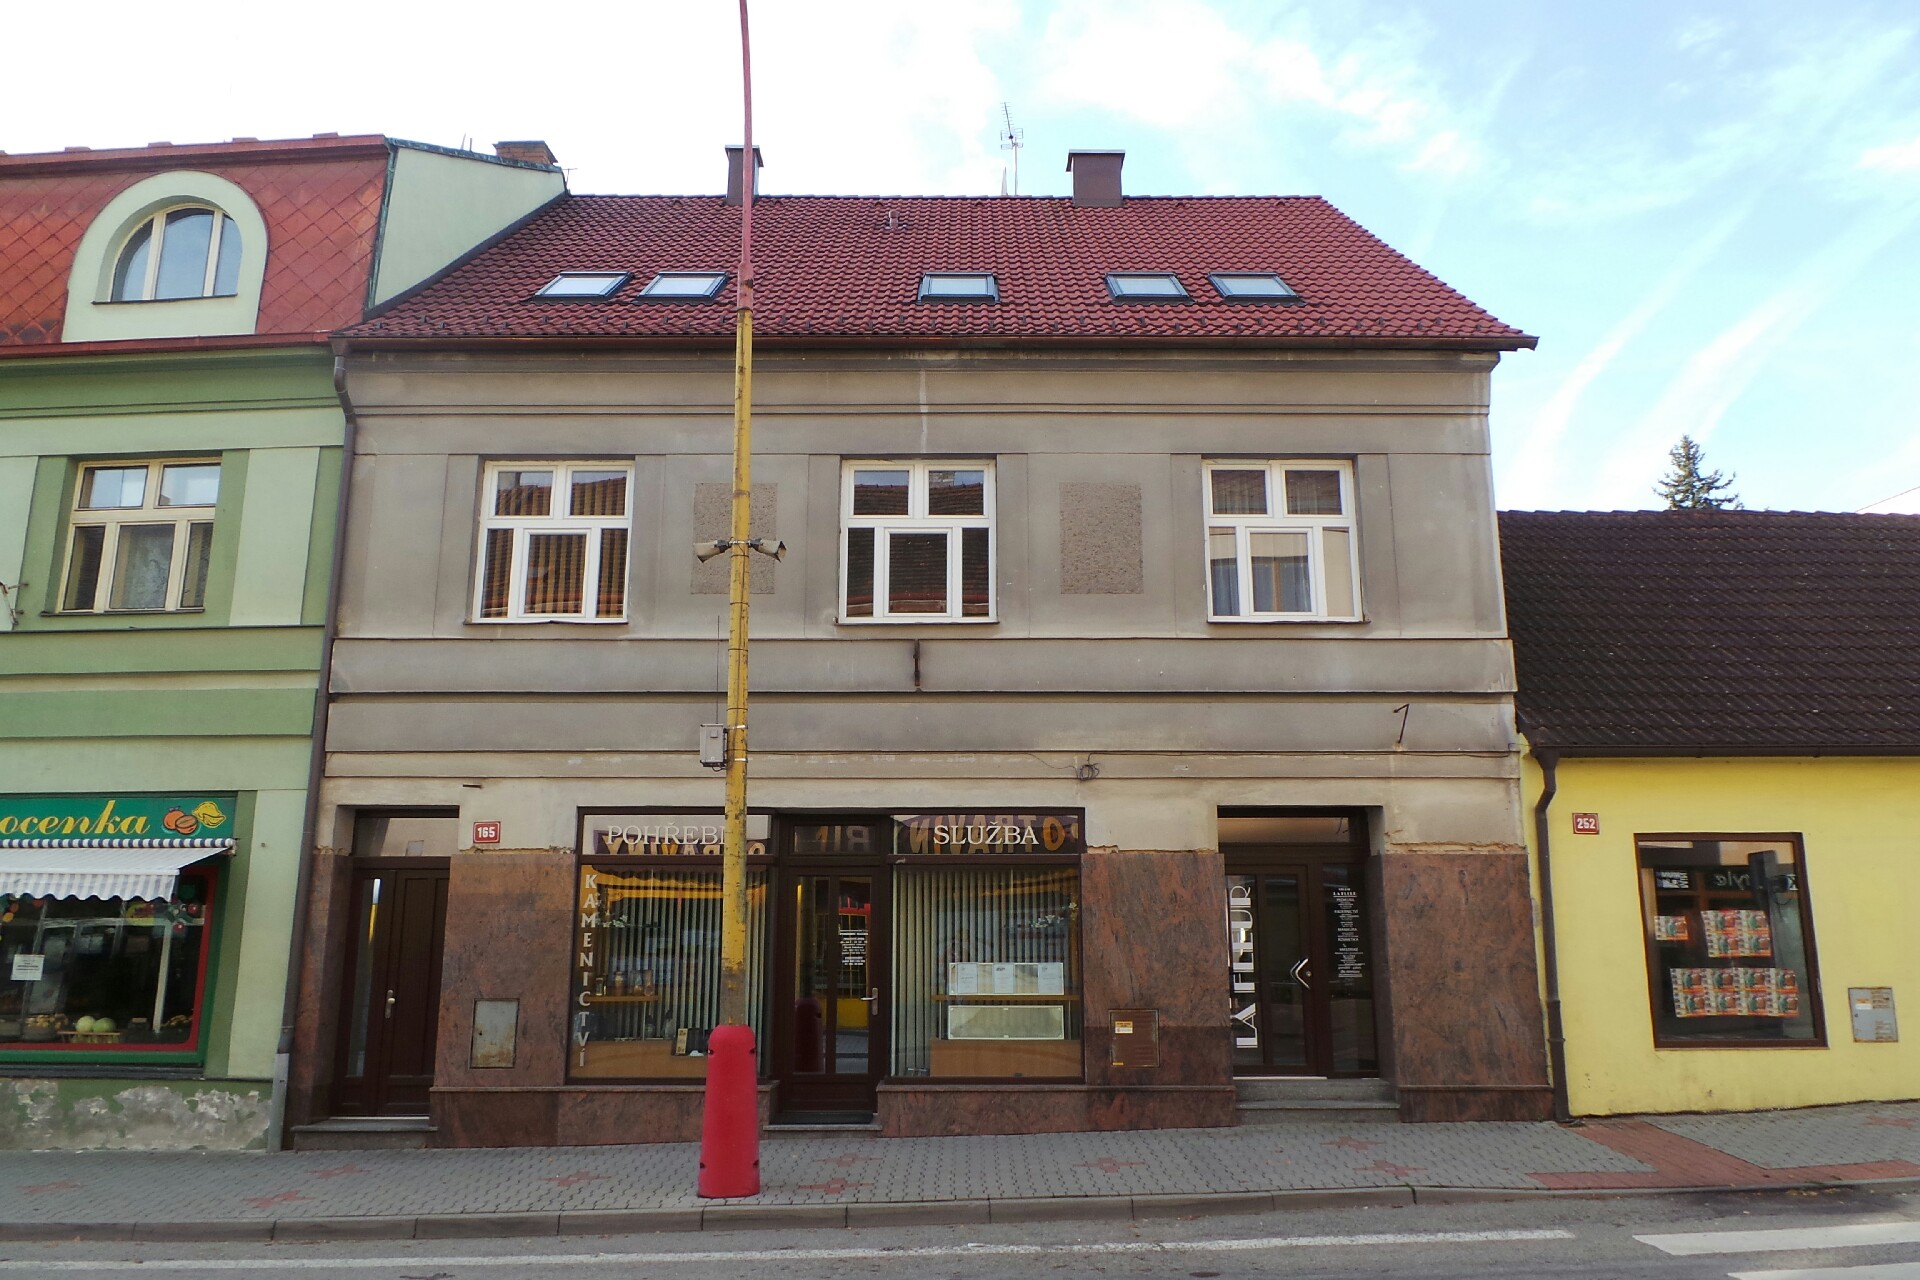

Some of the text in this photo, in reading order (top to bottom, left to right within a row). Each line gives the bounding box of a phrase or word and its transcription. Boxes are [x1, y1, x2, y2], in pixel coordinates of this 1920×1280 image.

[477, 826, 496, 838] 165
[933, 821, 1040, 845] SLUŽBA
[1576, 817, 1596, 829] 252
[578, 874, 597, 1067] KAMENICTVÍ
[1229, 885, 1258, 1048] LA FLEUR
